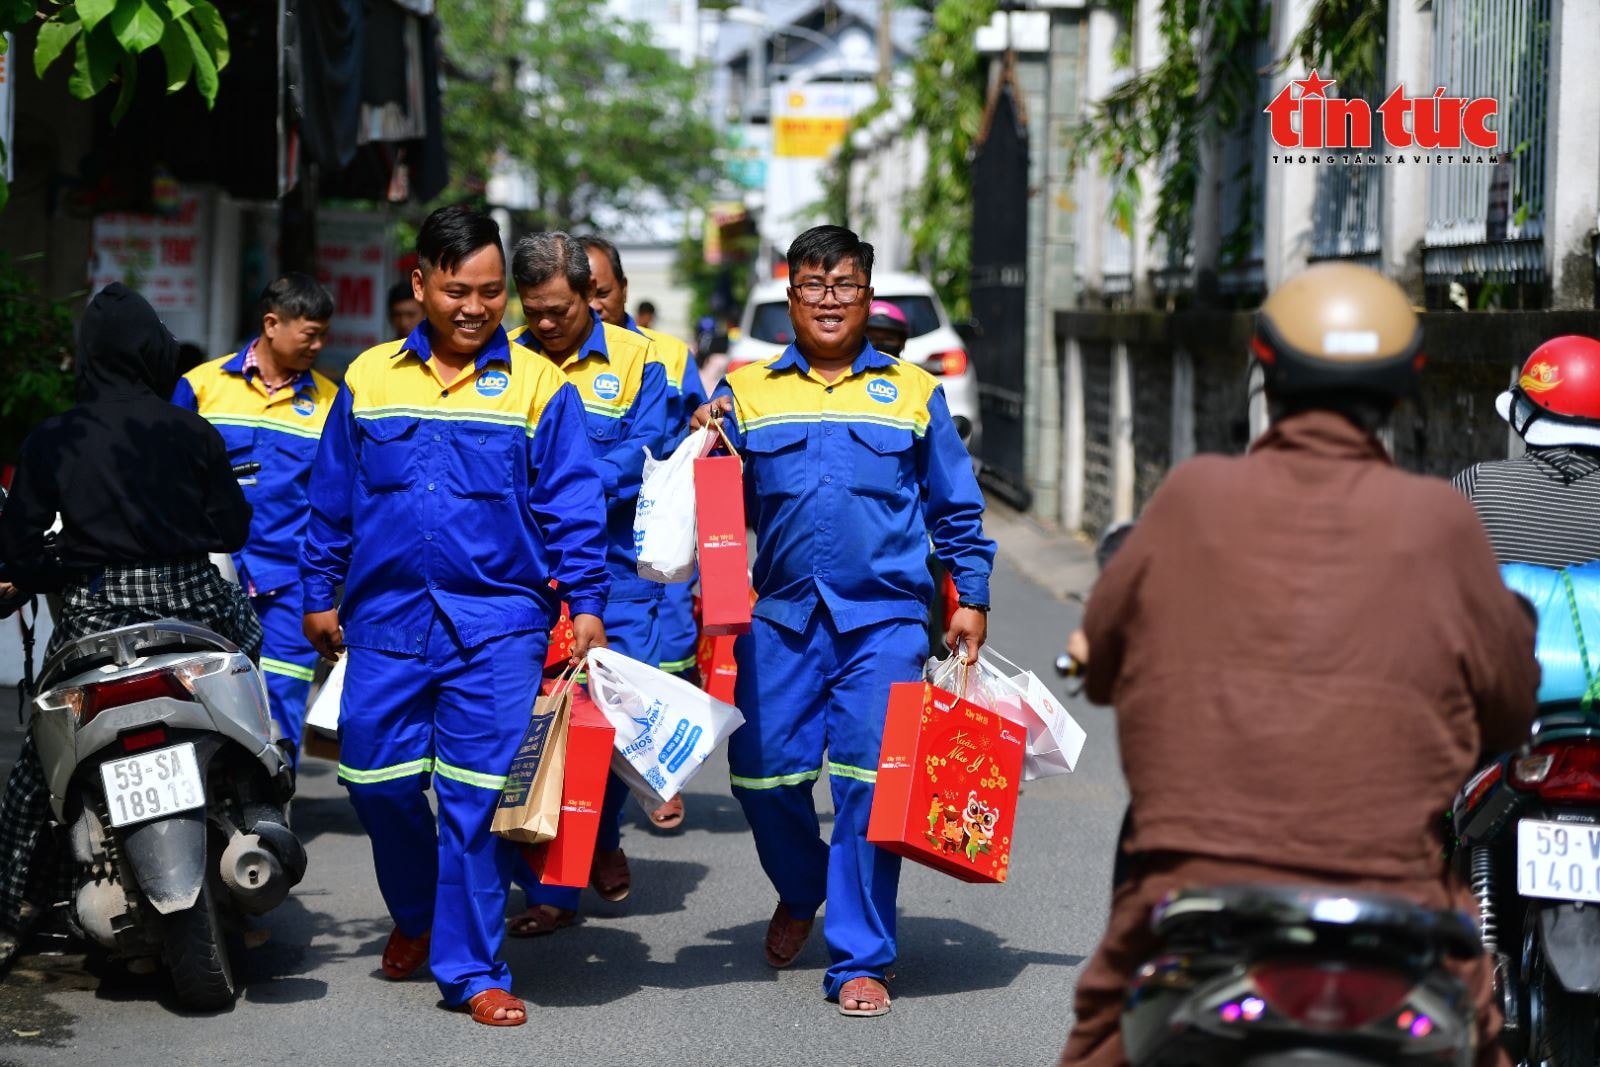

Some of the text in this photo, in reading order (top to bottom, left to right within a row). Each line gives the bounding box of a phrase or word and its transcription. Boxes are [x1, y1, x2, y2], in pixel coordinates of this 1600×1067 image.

[478, 376, 507, 388] UDC
[595, 379, 619, 391] UDC
[869, 382, 897, 397] UDC
[113, 750, 184, 791] 59-SA
[115, 780, 197, 822] 189.13
